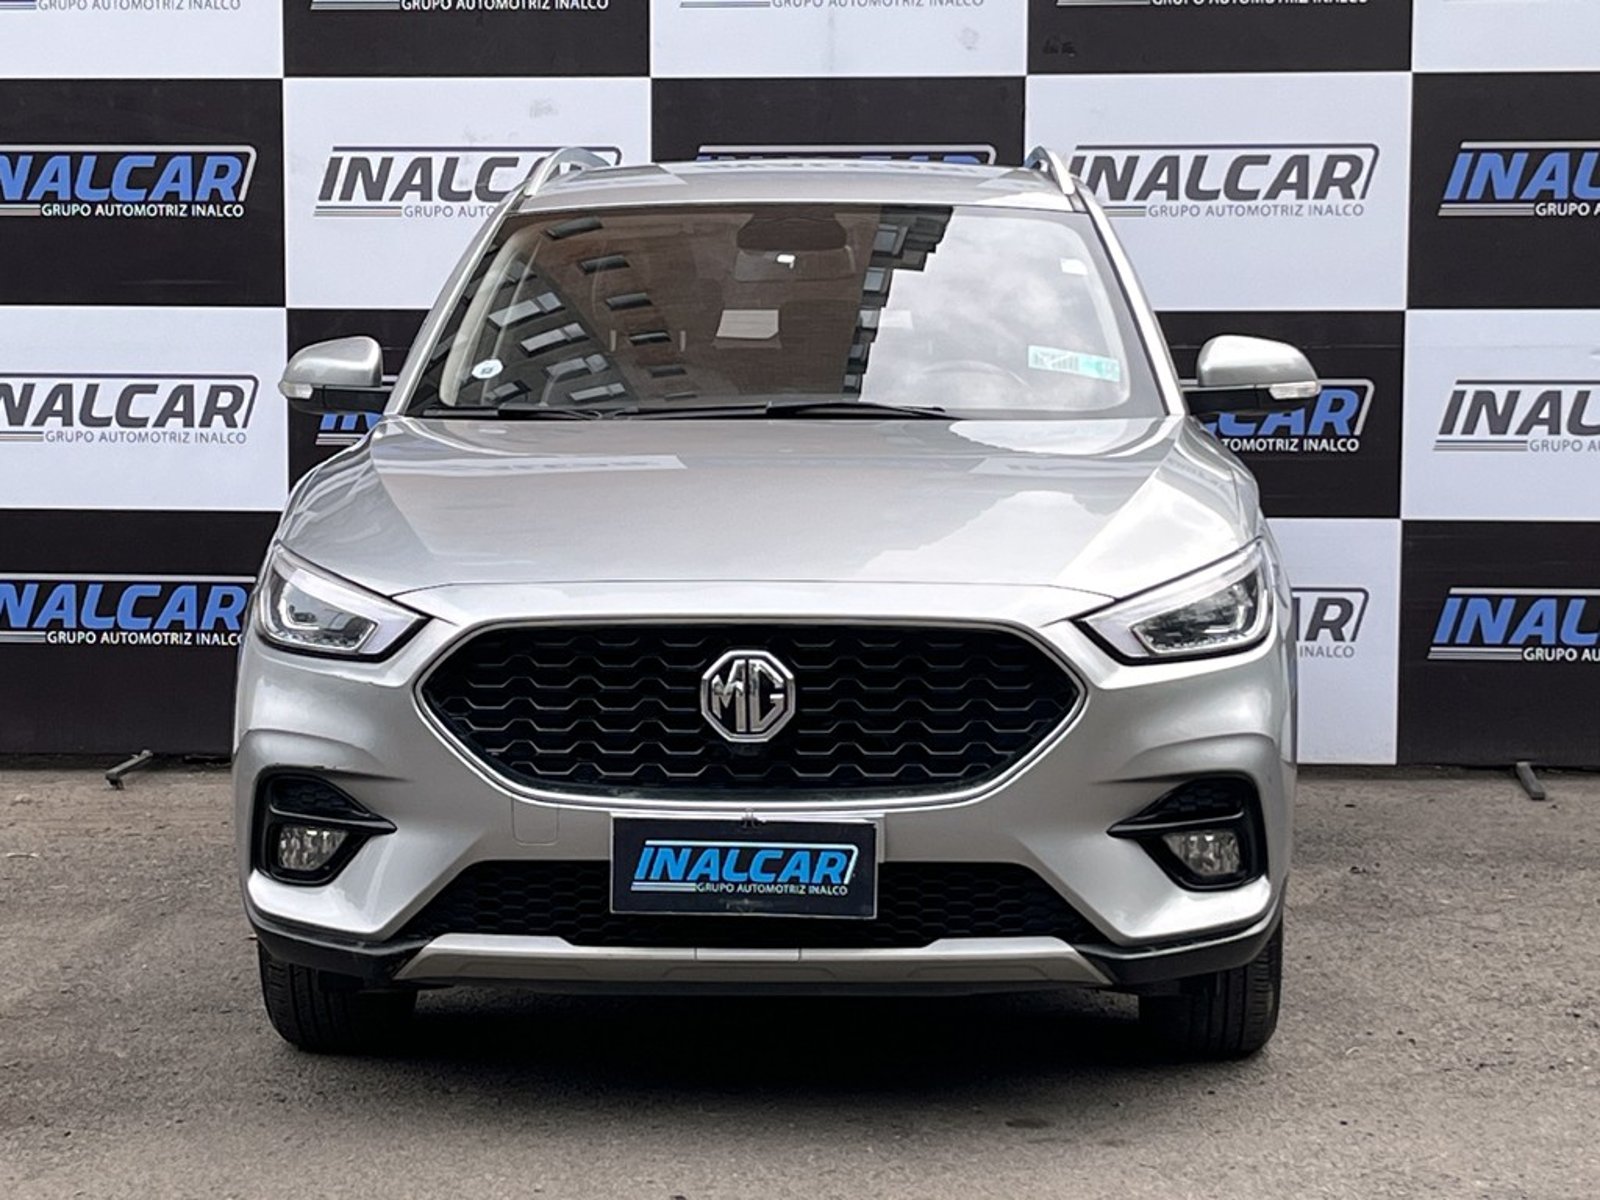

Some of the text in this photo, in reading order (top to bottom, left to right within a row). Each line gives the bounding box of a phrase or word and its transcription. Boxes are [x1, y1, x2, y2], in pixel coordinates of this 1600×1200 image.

[38, 0, 241, 10] GRUPO AUTOMOTRIZ INALCO
[402, 0, 609, 10] GRUPO AUTOMOTRIZ INALCO
[0, 155, 242, 201] NALCAR
[318, 156, 545, 202] INALC
[1443, 152, 1600, 200] INAL
[41, 203, 244, 217] GRUPO AUTOMOTRIZ INALCO
[404, 205, 454, 218] GRUPO
[1149, 204, 1364, 217] GRUPO AUTOMOTRIZ INALCO
[1535, 203, 1590, 216] GRUPO
[0, 383, 245, 428] NALCAR
[1439, 390, 1600, 436] INAL
[45, 430, 246, 444] GRUPO AUTOMOTRIZ INALCO
[1221, 438, 1359, 452] TOMOTRIZ INALCO
[1529, 439, 1583, 452] GRUPO
[0, 583, 247, 630] NALCAR
[1433, 597, 1600, 645] INAL
[47, 631, 96, 644] GRUPO
[100, 631, 192, 645] AUTOMOTRIZ
[1300, 645, 1355, 658] INALCO
[1523, 648, 1577, 661] GRUPO
[710, 658, 785, 733] MG
[634, 847, 848, 884] INALCAR
[697, 882, 848, 896] GRUPO AUTOMOTRIZ INALCO
